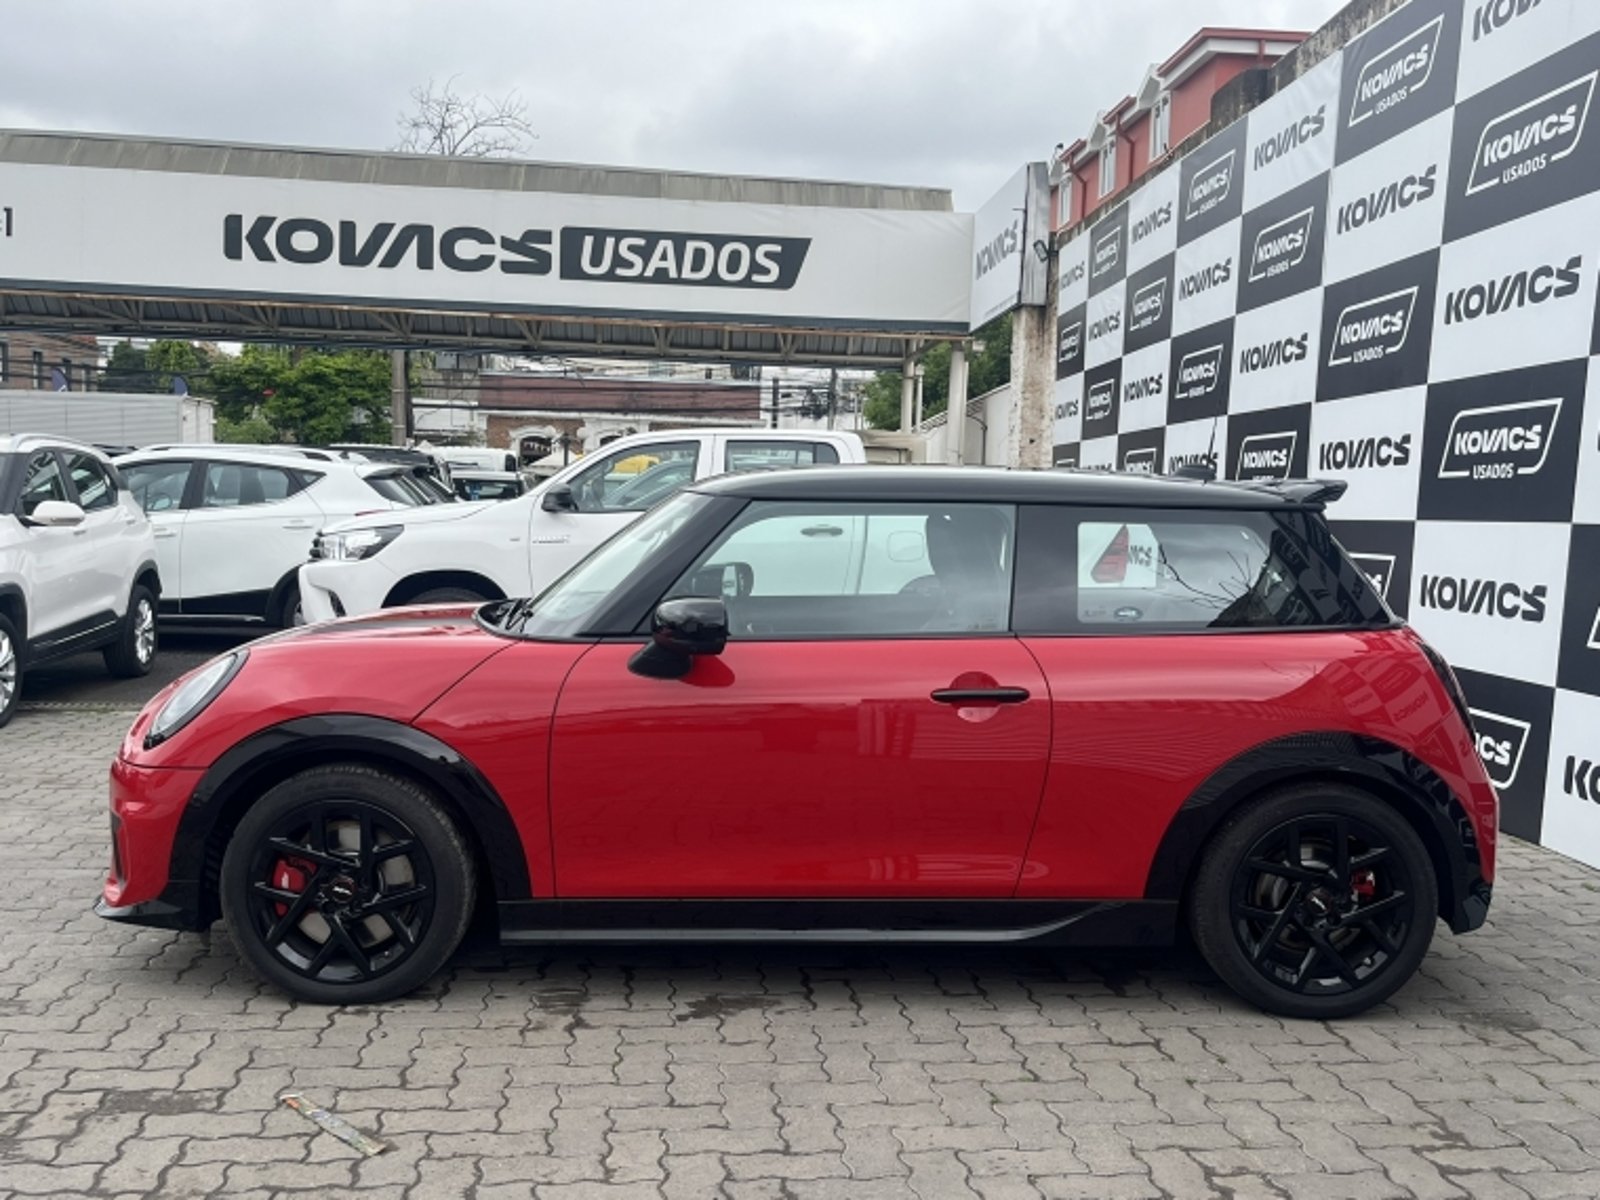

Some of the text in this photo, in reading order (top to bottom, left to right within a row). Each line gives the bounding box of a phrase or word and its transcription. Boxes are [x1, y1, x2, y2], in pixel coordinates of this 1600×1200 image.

[1361, 44, 1429, 101] KOVACS
[1374, 86, 1408, 114] USADOS
[1253, 103, 1326, 171] KOVACS
[1483, 104, 1577, 167] KOVACS
[1191, 167, 1229, 202] KOVACS
[1502, 153, 1548, 184] USADOS
[1337, 163, 1437, 235] KOVACS
[224, 214, 783, 284] KOVACS USADOS
[1257, 227, 1304, 263] KOVACS
[1179, 257, 1232, 301] KOVACS
[1444, 255, 1582, 325] KOVACS
[1340, 310, 1404, 346] KOVACS
[1182, 361, 1215, 383] KOVACS
[1240, 333, 1308, 374] KOVACS
[1353, 345, 1384, 363] USADOS
[1243, 448, 1287, 469] KOVACS
[1319, 433, 1411, 472] KOVACS
[1454, 424, 1542, 456] KOVACS
[1473, 462, 1514, 480] USADOS
[1420, 574, 1548, 623] KOVACS
